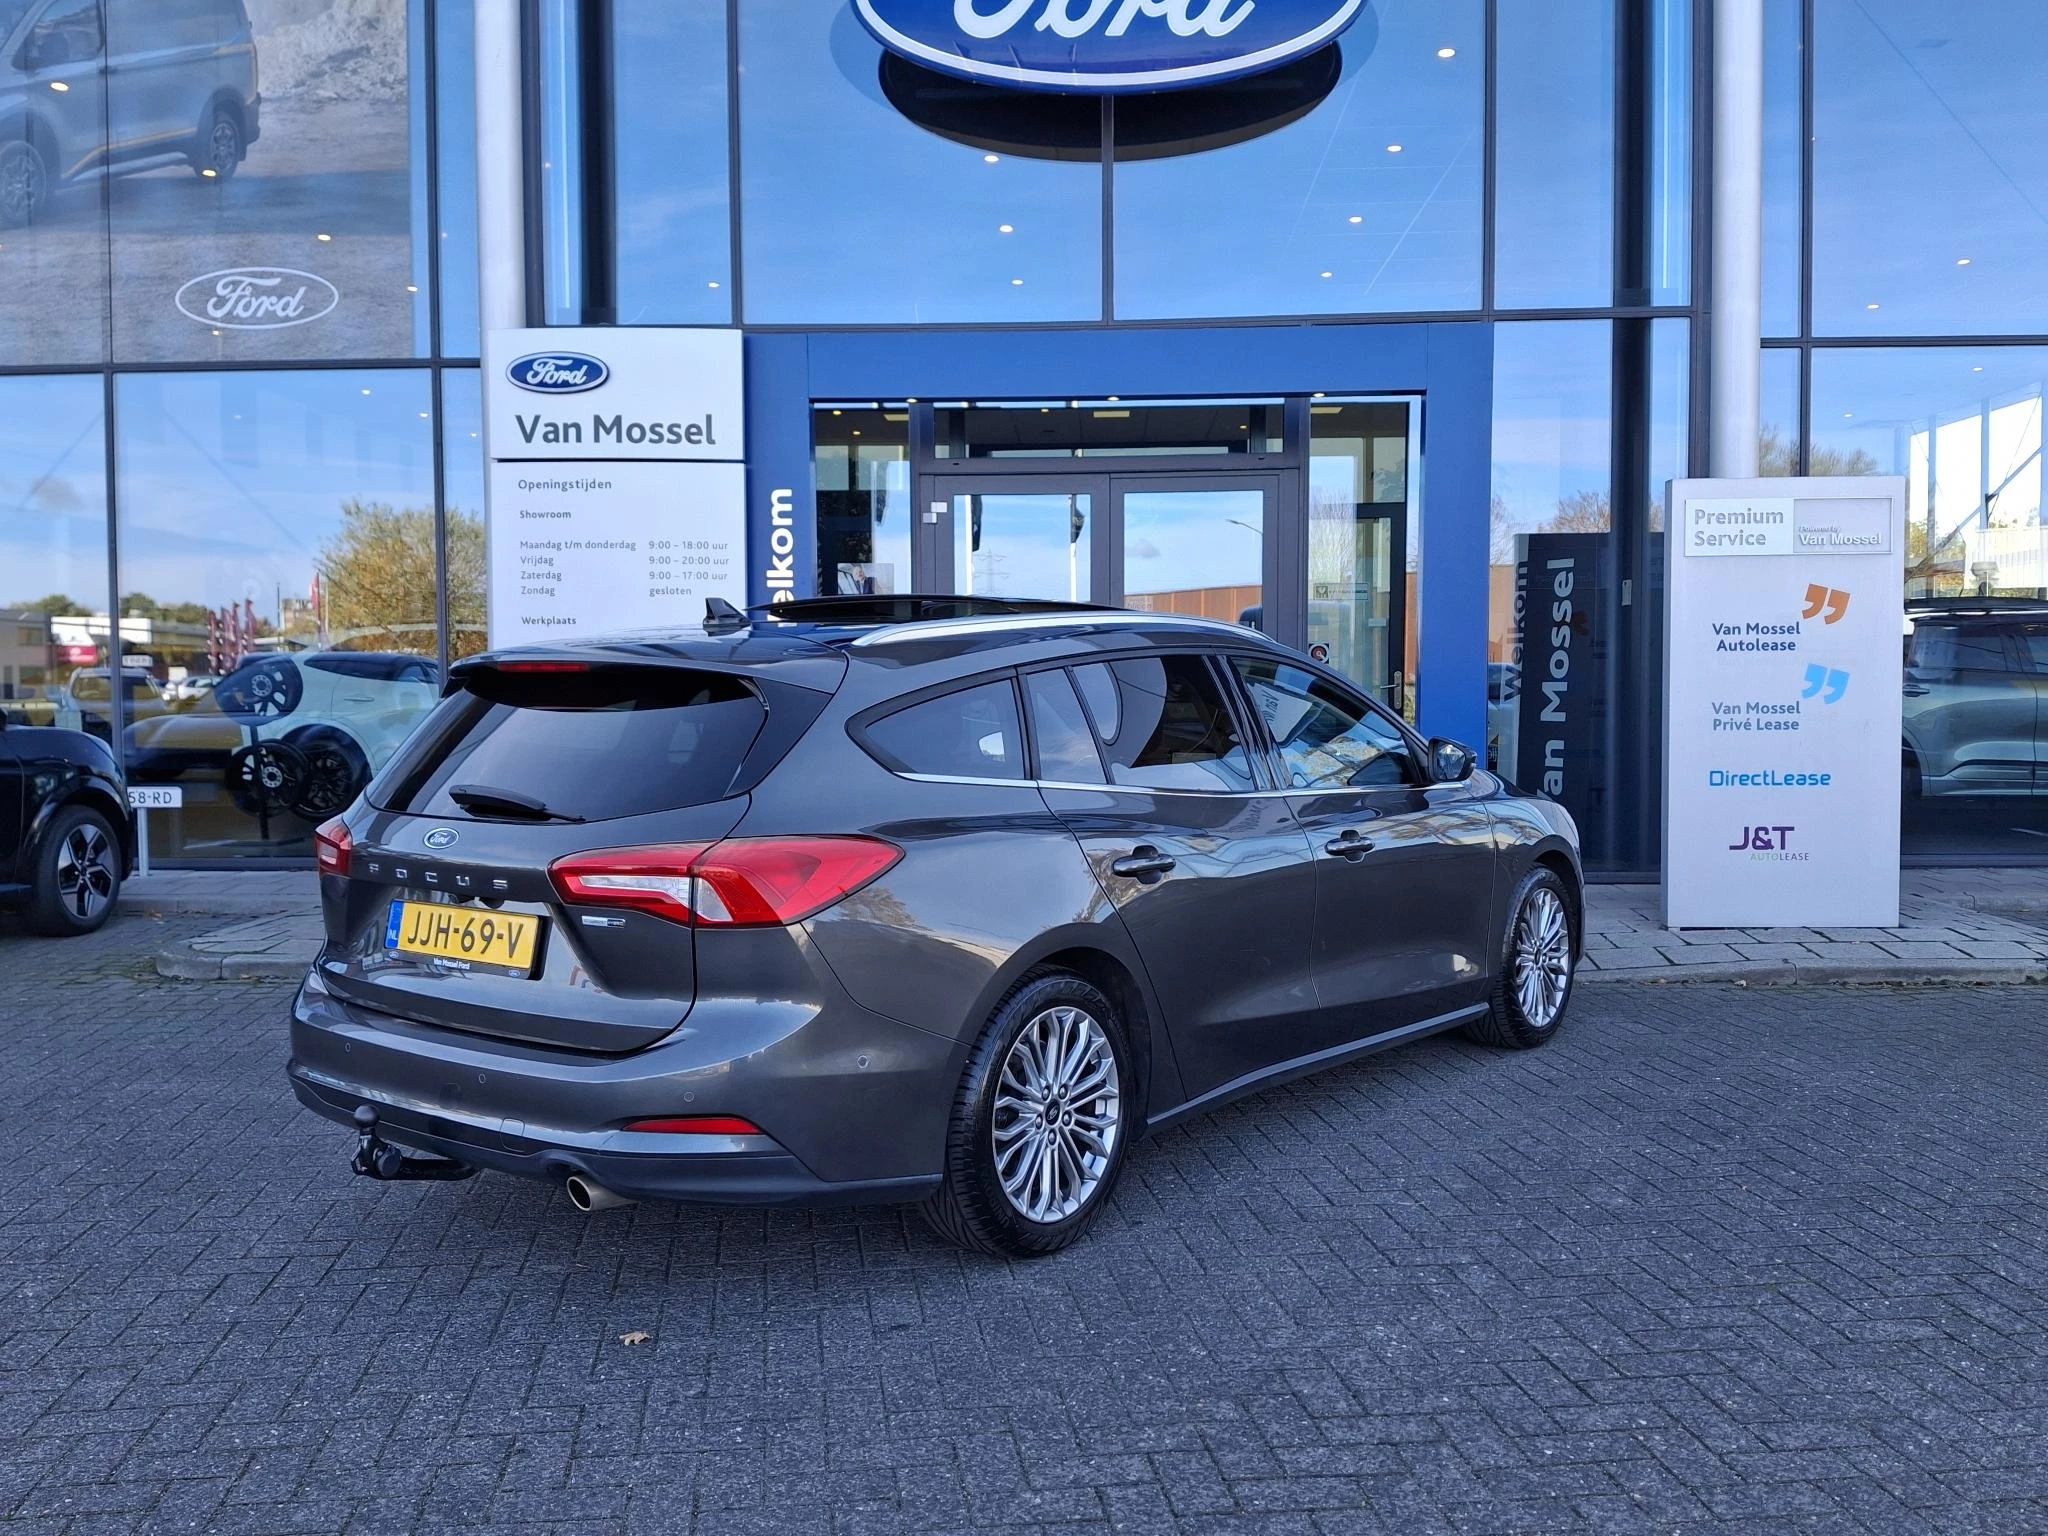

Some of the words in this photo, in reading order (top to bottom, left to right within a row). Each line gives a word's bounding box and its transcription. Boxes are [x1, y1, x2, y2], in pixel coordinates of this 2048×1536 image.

[953, 0, 1254, 38] or
[207, 276, 307, 318] Ford
[526, 357, 587, 386] Ford
[515, 414, 582, 444] Van
[593, 414, 716, 445] Mossel
[518, 479, 612, 493] Openingstijden
[519, 509, 572, 519] Showroom
[1694, 508, 1784, 526] Premium
[1694, 529, 1767, 547] Service
[1799, 533, 1827, 545] Van
[1830, 532, 1882, 545] Mossel
[520, 540, 562, 551] Maandag
[565, 540, 582, 550] t/m
[585, 540, 637, 551] donderdag
[649, 541, 671, 550] 9:00
[682, 541, 709, 550] 18:00
[520, 556, 554, 567] Vrijdag
[649, 556, 671, 565] 9:00
[682, 556, 710, 565] 20:00
[766, 488, 798, 628] elkom
[520, 571, 562, 582] Zaterdag
[649, 571, 671, 580] 9:00
[682, 571, 709, 580] 17:00
[520, 586, 556, 597] Zondag
[649, 586, 692, 597] gesloten
[521, 616, 577, 627] Werkplaats
[1712, 622, 1741, 635] Van
[1746, 621, 1801, 635] Mossel
[1502, 560, 1528, 702] Welkom
[1540, 558, 1575, 722] Mossel
[1716, 638, 1797, 652] Autolease
[1712, 702, 1742, 715] Van
[1746, 700, 1801, 715] Mossel
[1712, 717, 1752, 731] Privé
[1756, 718, 1800, 731] Lease
[1709, 770, 1832, 786] DirectLease
[1729, 826, 1795, 850] J&T
[1750, 852, 1810, 861] AUTOLEASE
[369, 863, 508, 890] FOCUS
[389, 930, 398, 942] NL
[407, 911, 524, 959] JJH-69-V
